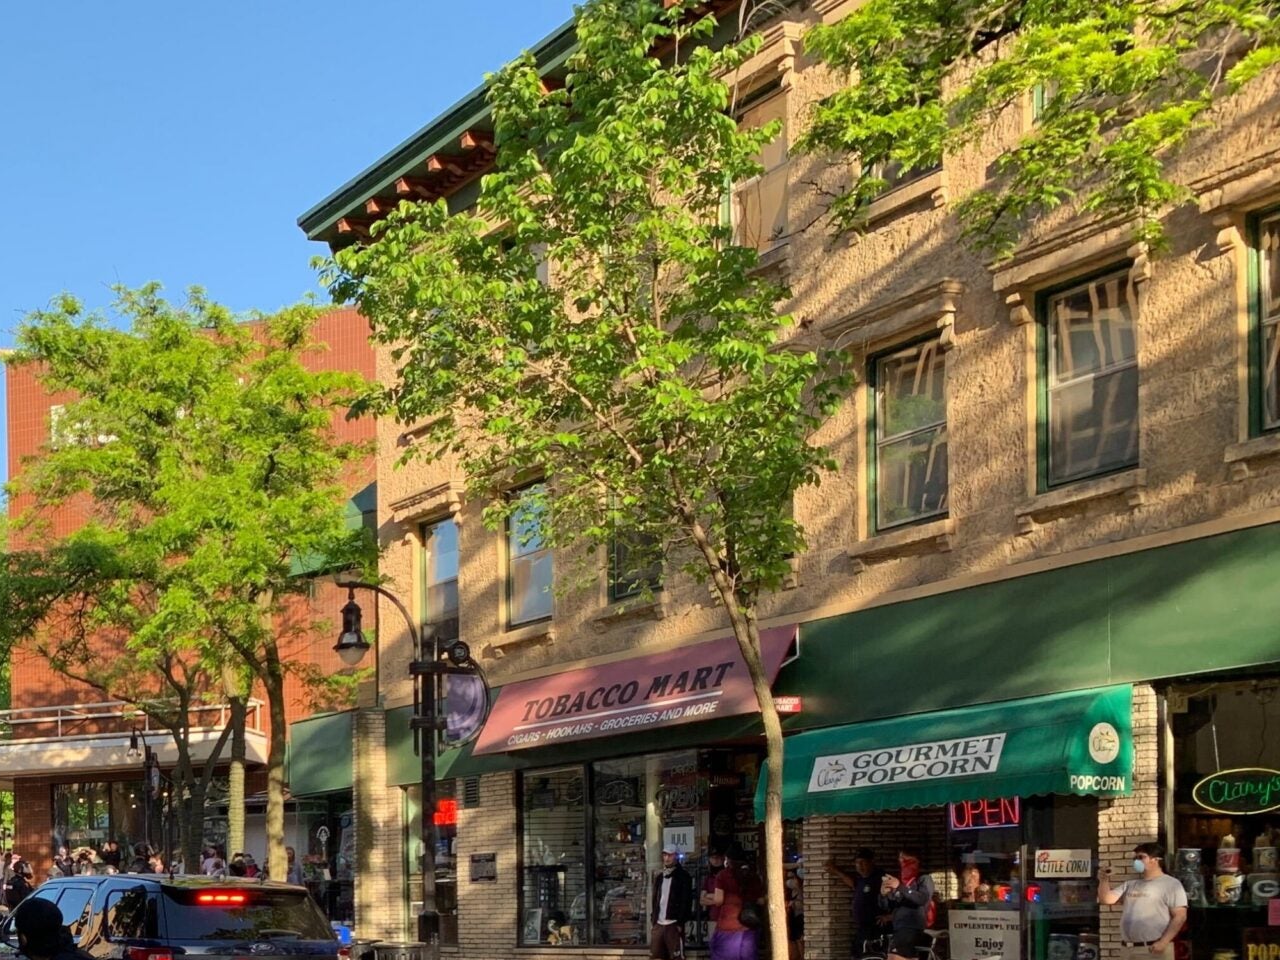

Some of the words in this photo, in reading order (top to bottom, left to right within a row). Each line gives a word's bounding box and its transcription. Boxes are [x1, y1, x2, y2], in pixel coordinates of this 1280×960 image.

[521, 680, 639, 722] TOBACCO
[645, 661, 736, 700] MART
[507, 730, 541, 746] CIGARS
[546, 722, 593, 741] HOOKAHS
[600, 711, 658, 731] GROCERIES
[659, 707, 683, 722] AND
[683, 700, 719, 717] MORE
[852, 736, 1002, 769] GOURMET
[849, 754, 996, 787] POPCORN
[1070, 775, 1125, 792] POPCORN
[953, 798, 1018, 827] OPEN
[1036, 860, 1065, 873] KETTLE
[1066, 859, 1089, 873] CORN
[974, 937, 1004, 950] Enjoy
